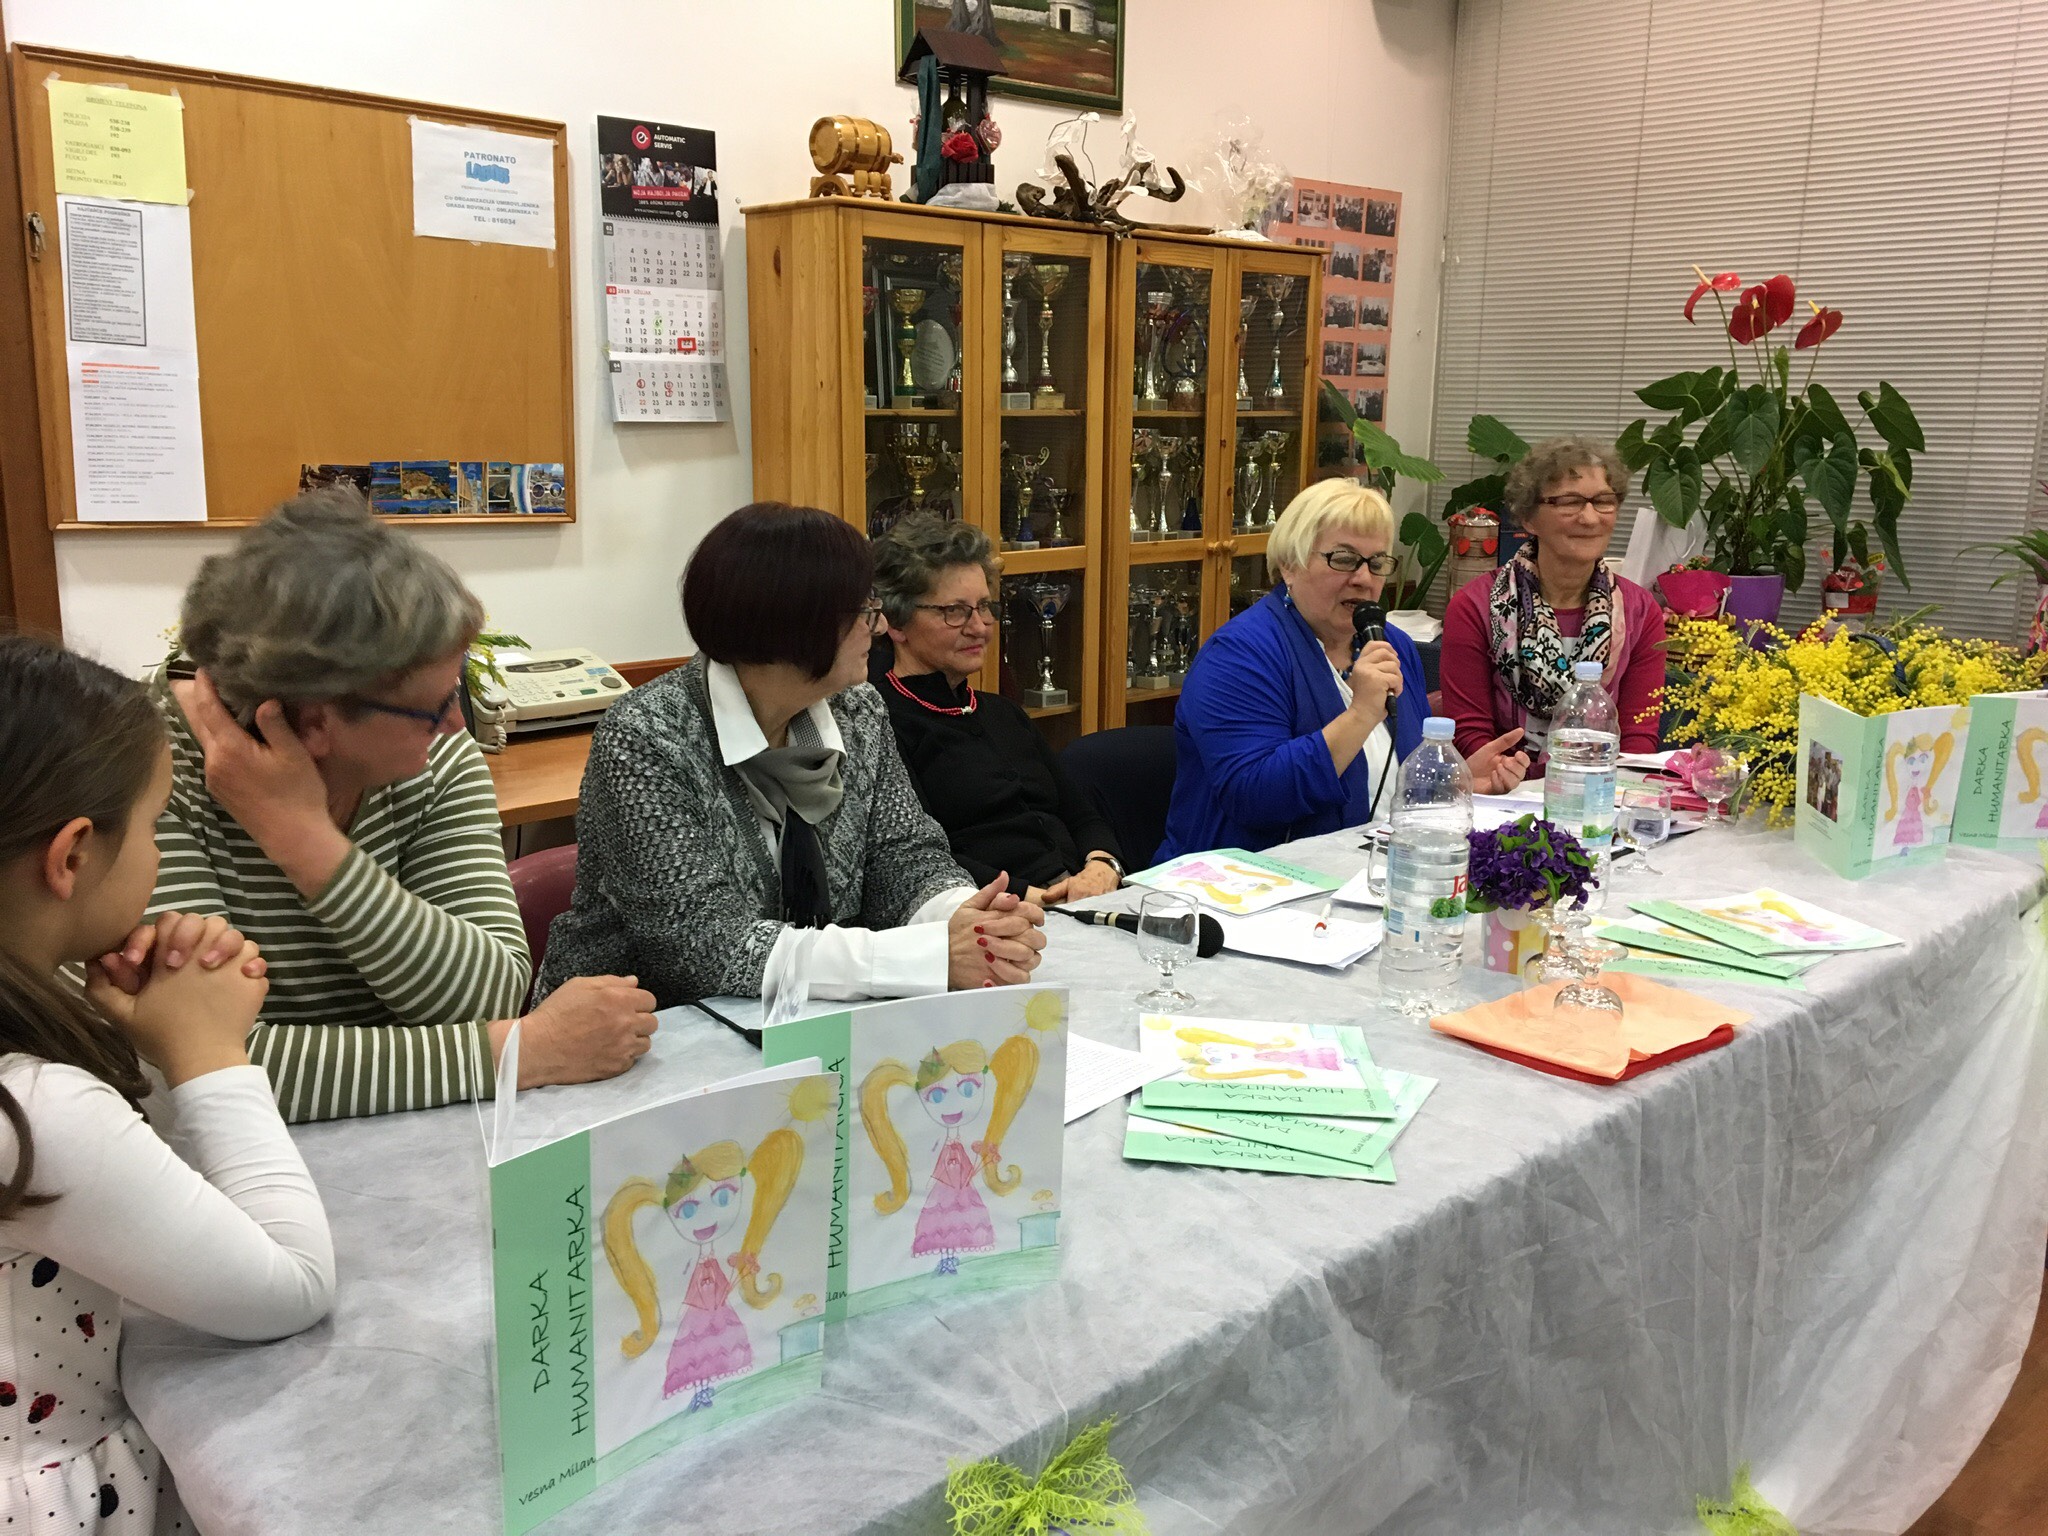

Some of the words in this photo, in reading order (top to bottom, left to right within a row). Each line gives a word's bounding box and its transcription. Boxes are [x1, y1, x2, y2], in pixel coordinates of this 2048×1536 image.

[654, 134, 686, 144] AUTOMATIC
[464, 152, 516, 164] PATRONATO
[1973, 747, 1989, 795] DARKA
[1988, 719, 2012, 823] HUMANITARKA
[1867, 737, 1885, 847] HUMANITARKA
[1449, 873, 1469, 900] Ja
[1179, 1081, 1345, 1095] HUMANITARKA
[1223, 1092, 1304, 1103] DARKA
[1215, 1112, 1292, 1134] DARKA
[1210, 1149, 1297, 1163] DARKA
[565, 1184, 590, 1436] HUMANITARKA
[531, 1267, 549, 1394] DARKA
